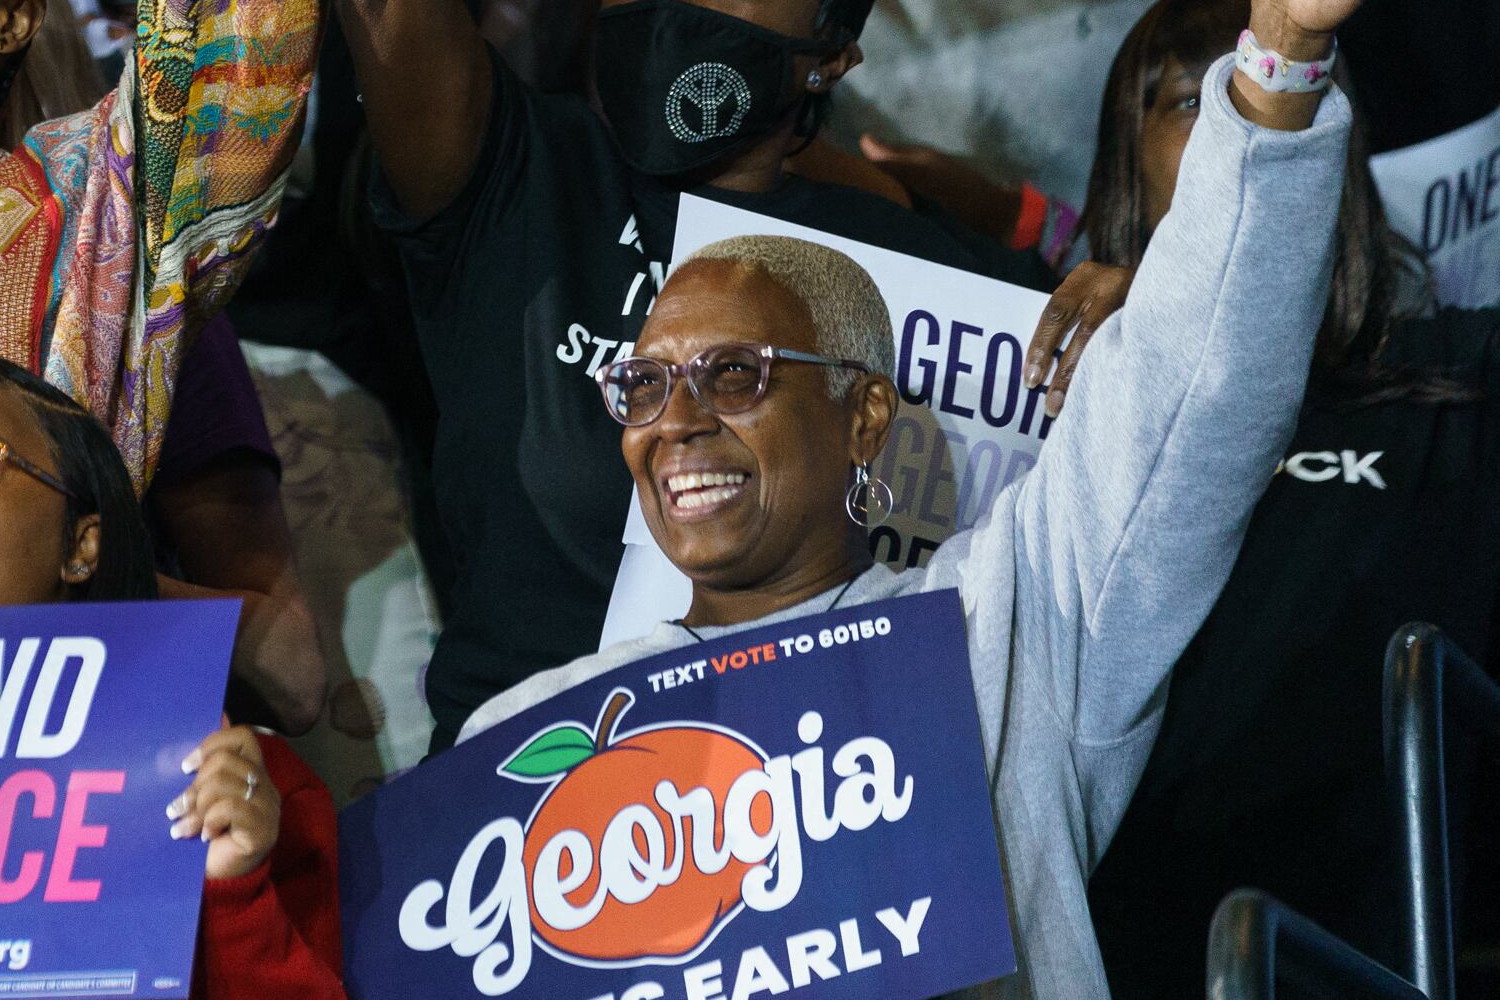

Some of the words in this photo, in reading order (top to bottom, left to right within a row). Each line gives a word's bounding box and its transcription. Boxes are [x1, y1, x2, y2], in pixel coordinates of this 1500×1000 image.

[1422, 146, 1500, 253] ONE
[647, 659, 708, 693] TEXT
[711, 644, 777, 674] VOTE
[779, 633, 814, 657] TO
[818, 616, 891, 650] 60150
[400, 711, 913, 996] Georgia
[683, 896, 932, 1000] EARLY
